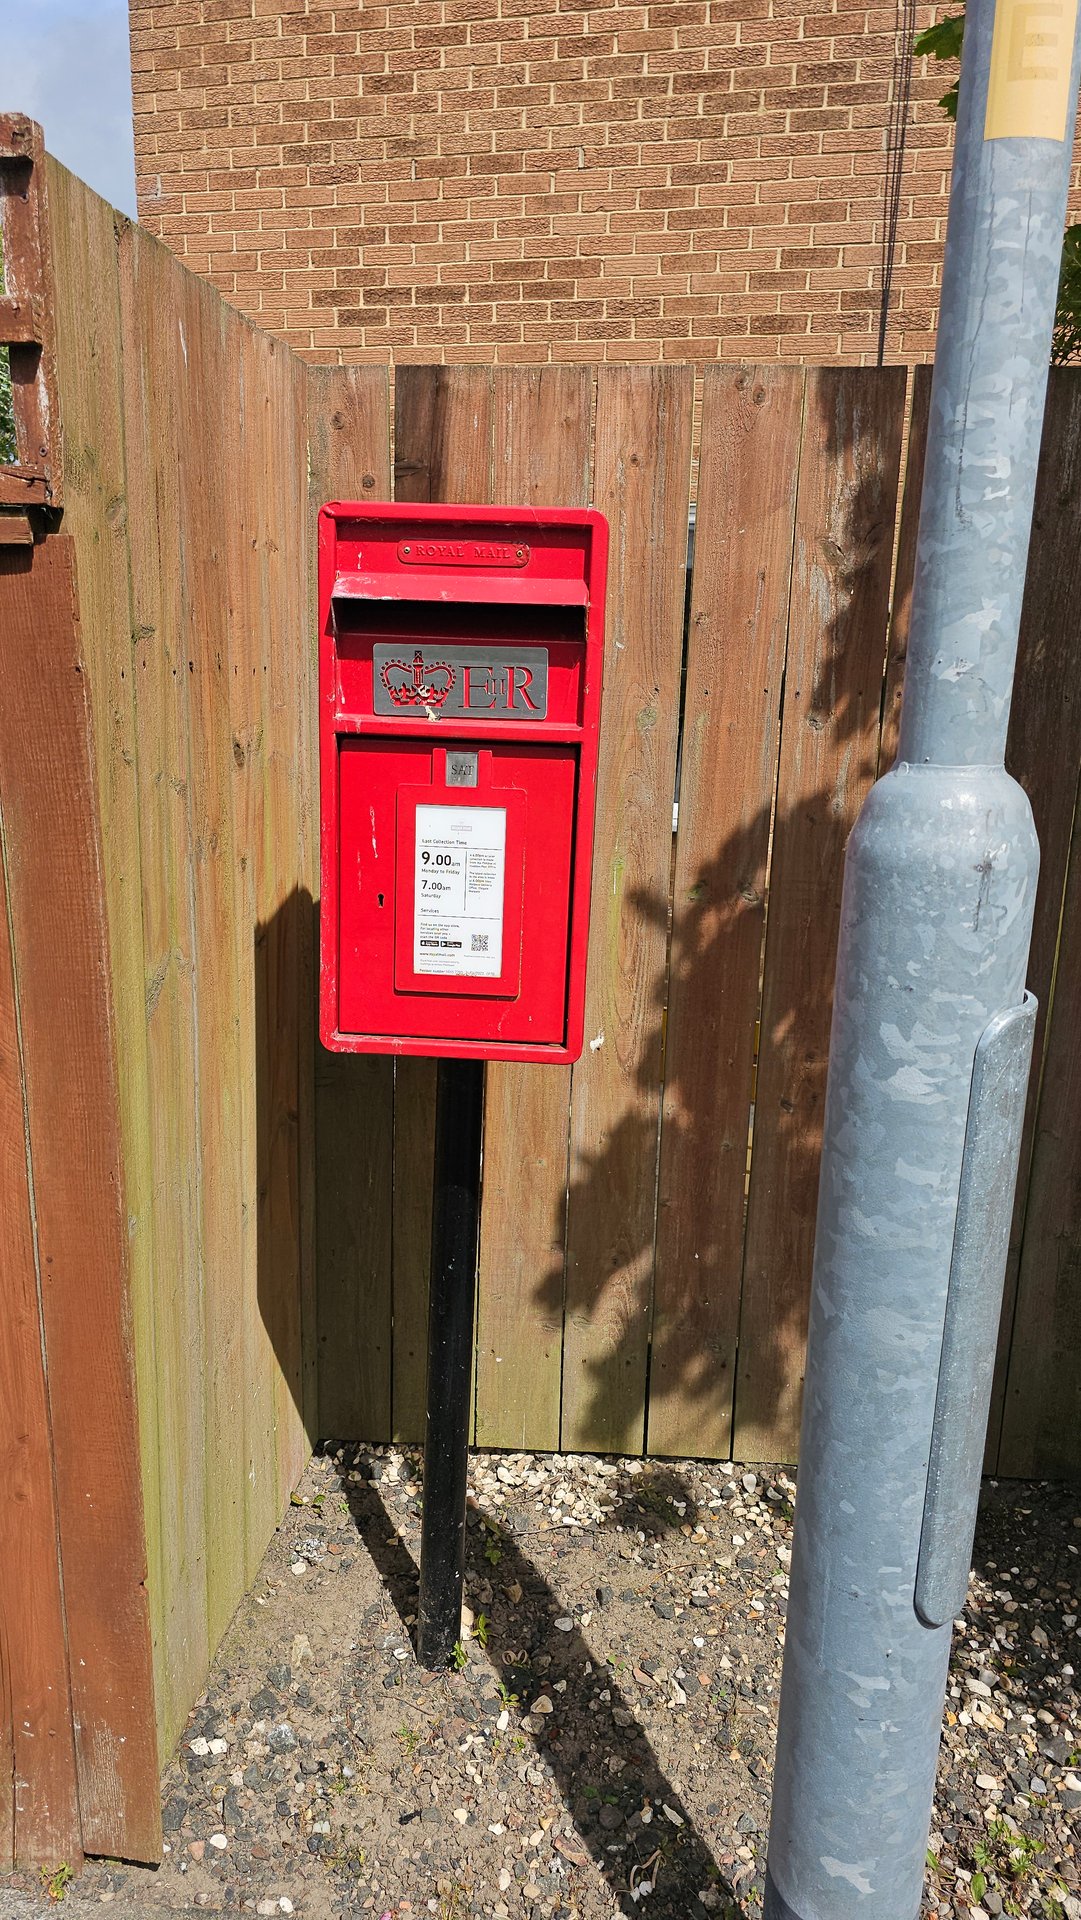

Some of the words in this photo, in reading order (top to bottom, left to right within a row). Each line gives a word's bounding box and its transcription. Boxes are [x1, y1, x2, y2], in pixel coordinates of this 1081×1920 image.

[415, 544, 465, 557] ROYAL
[473, 546, 511, 559] MAIL
[421, 851, 461, 867] 9.00am
[421, 879, 451, 891] 7.00am
